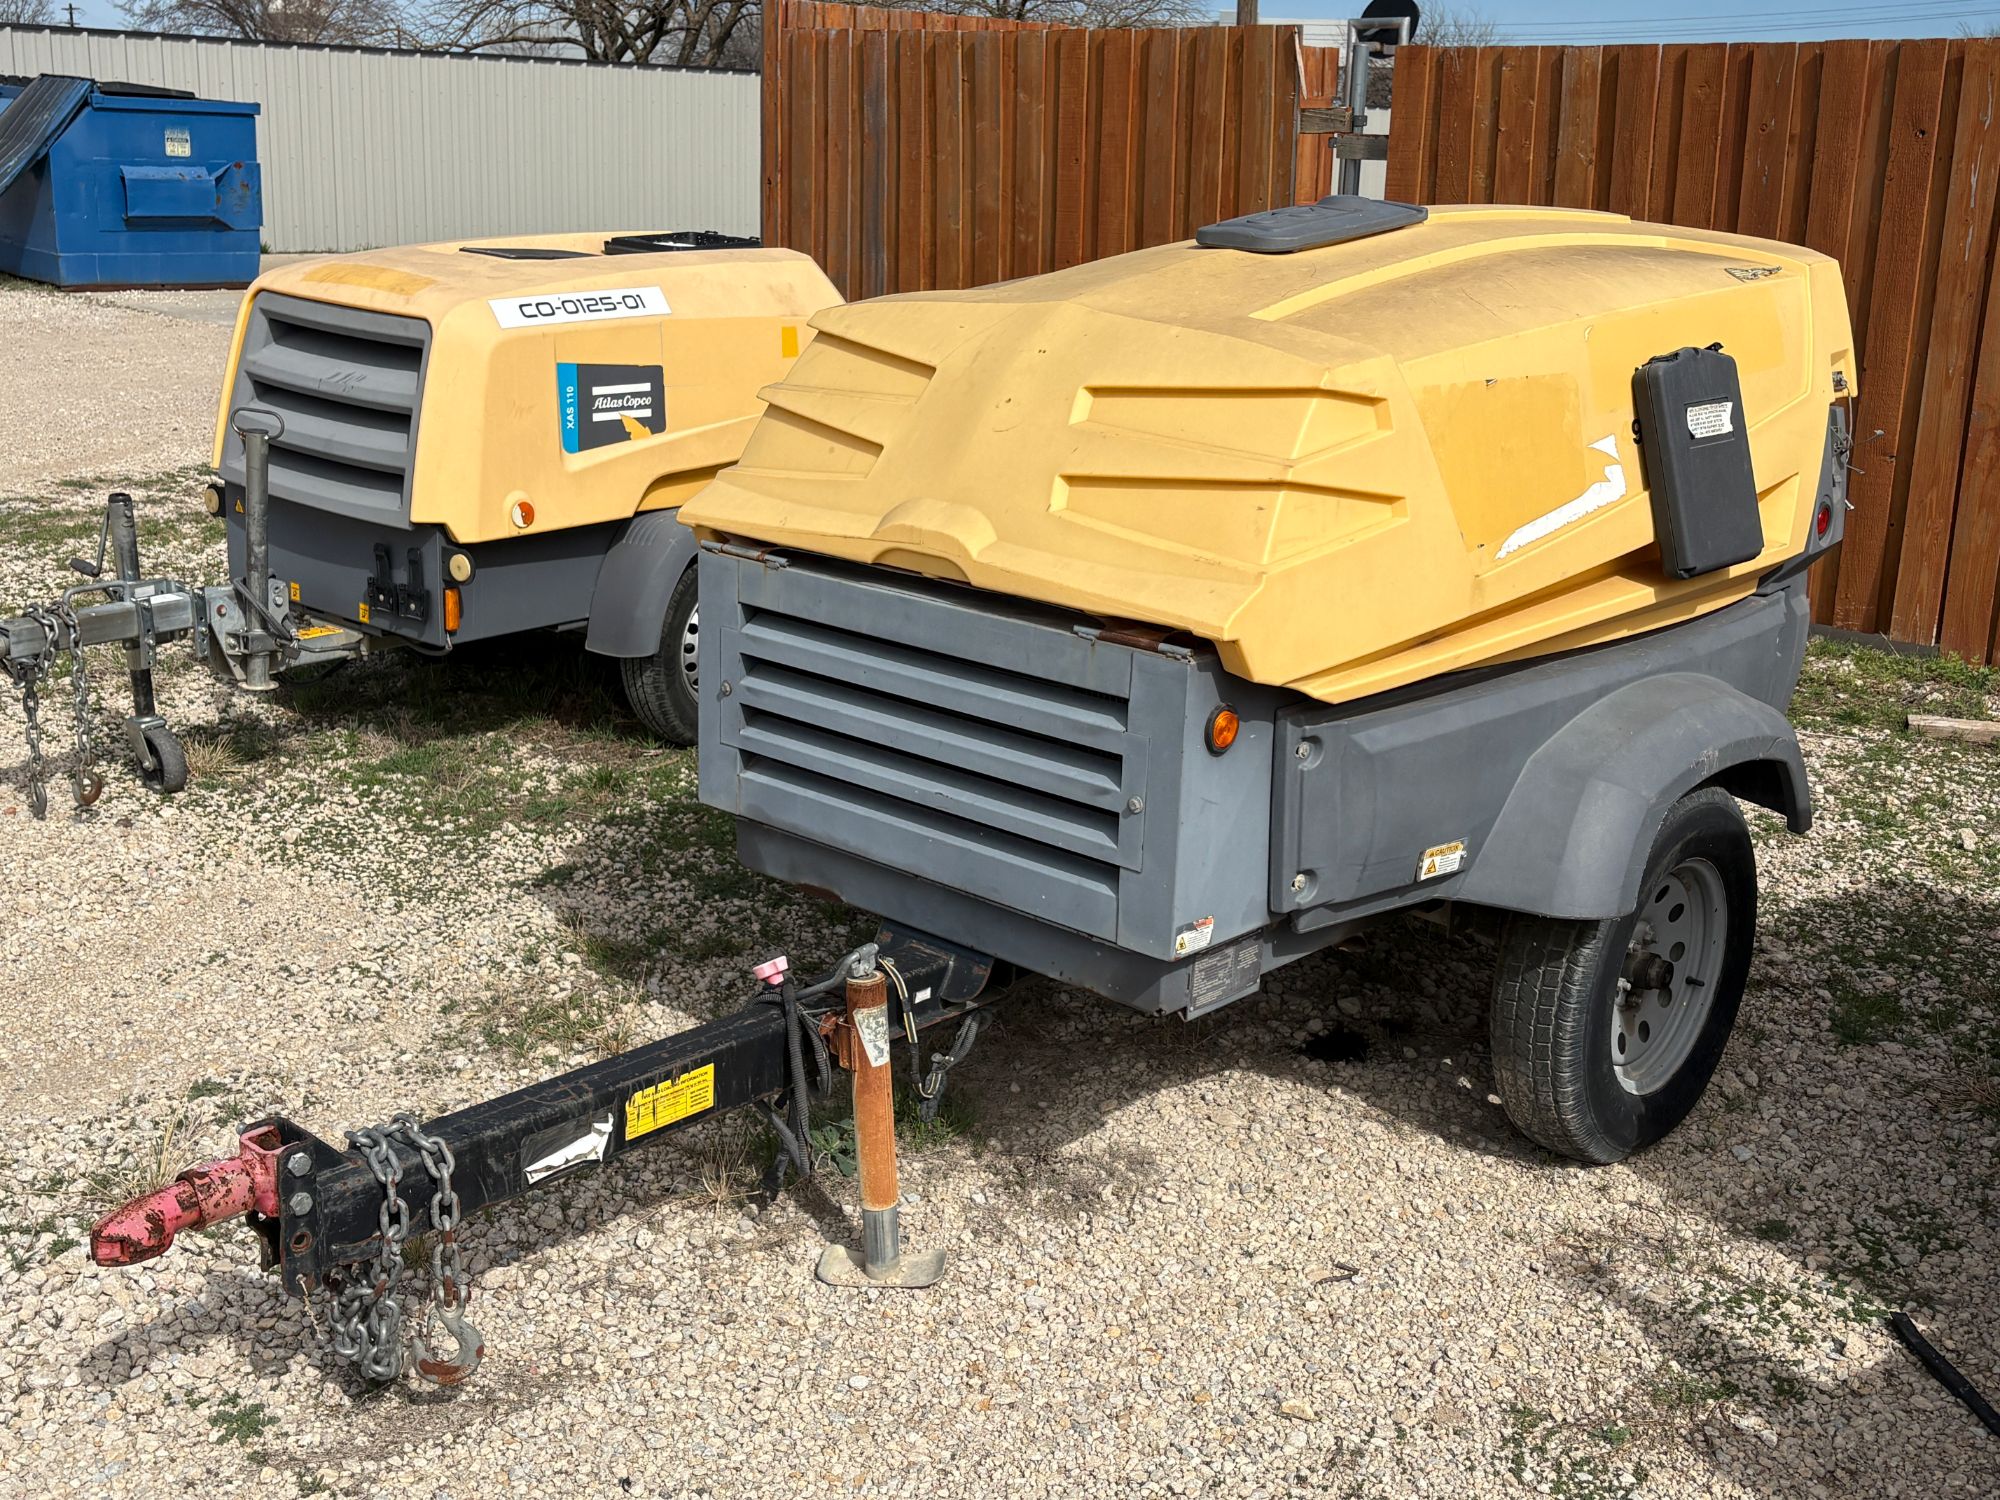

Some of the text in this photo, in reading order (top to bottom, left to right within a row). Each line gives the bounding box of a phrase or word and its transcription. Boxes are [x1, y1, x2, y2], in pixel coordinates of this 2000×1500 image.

[518, 294, 646, 319] CO-0125-01
[566, 386, 575, 429] XAS 110
[592, 395, 652, 410] Atlas Copco
